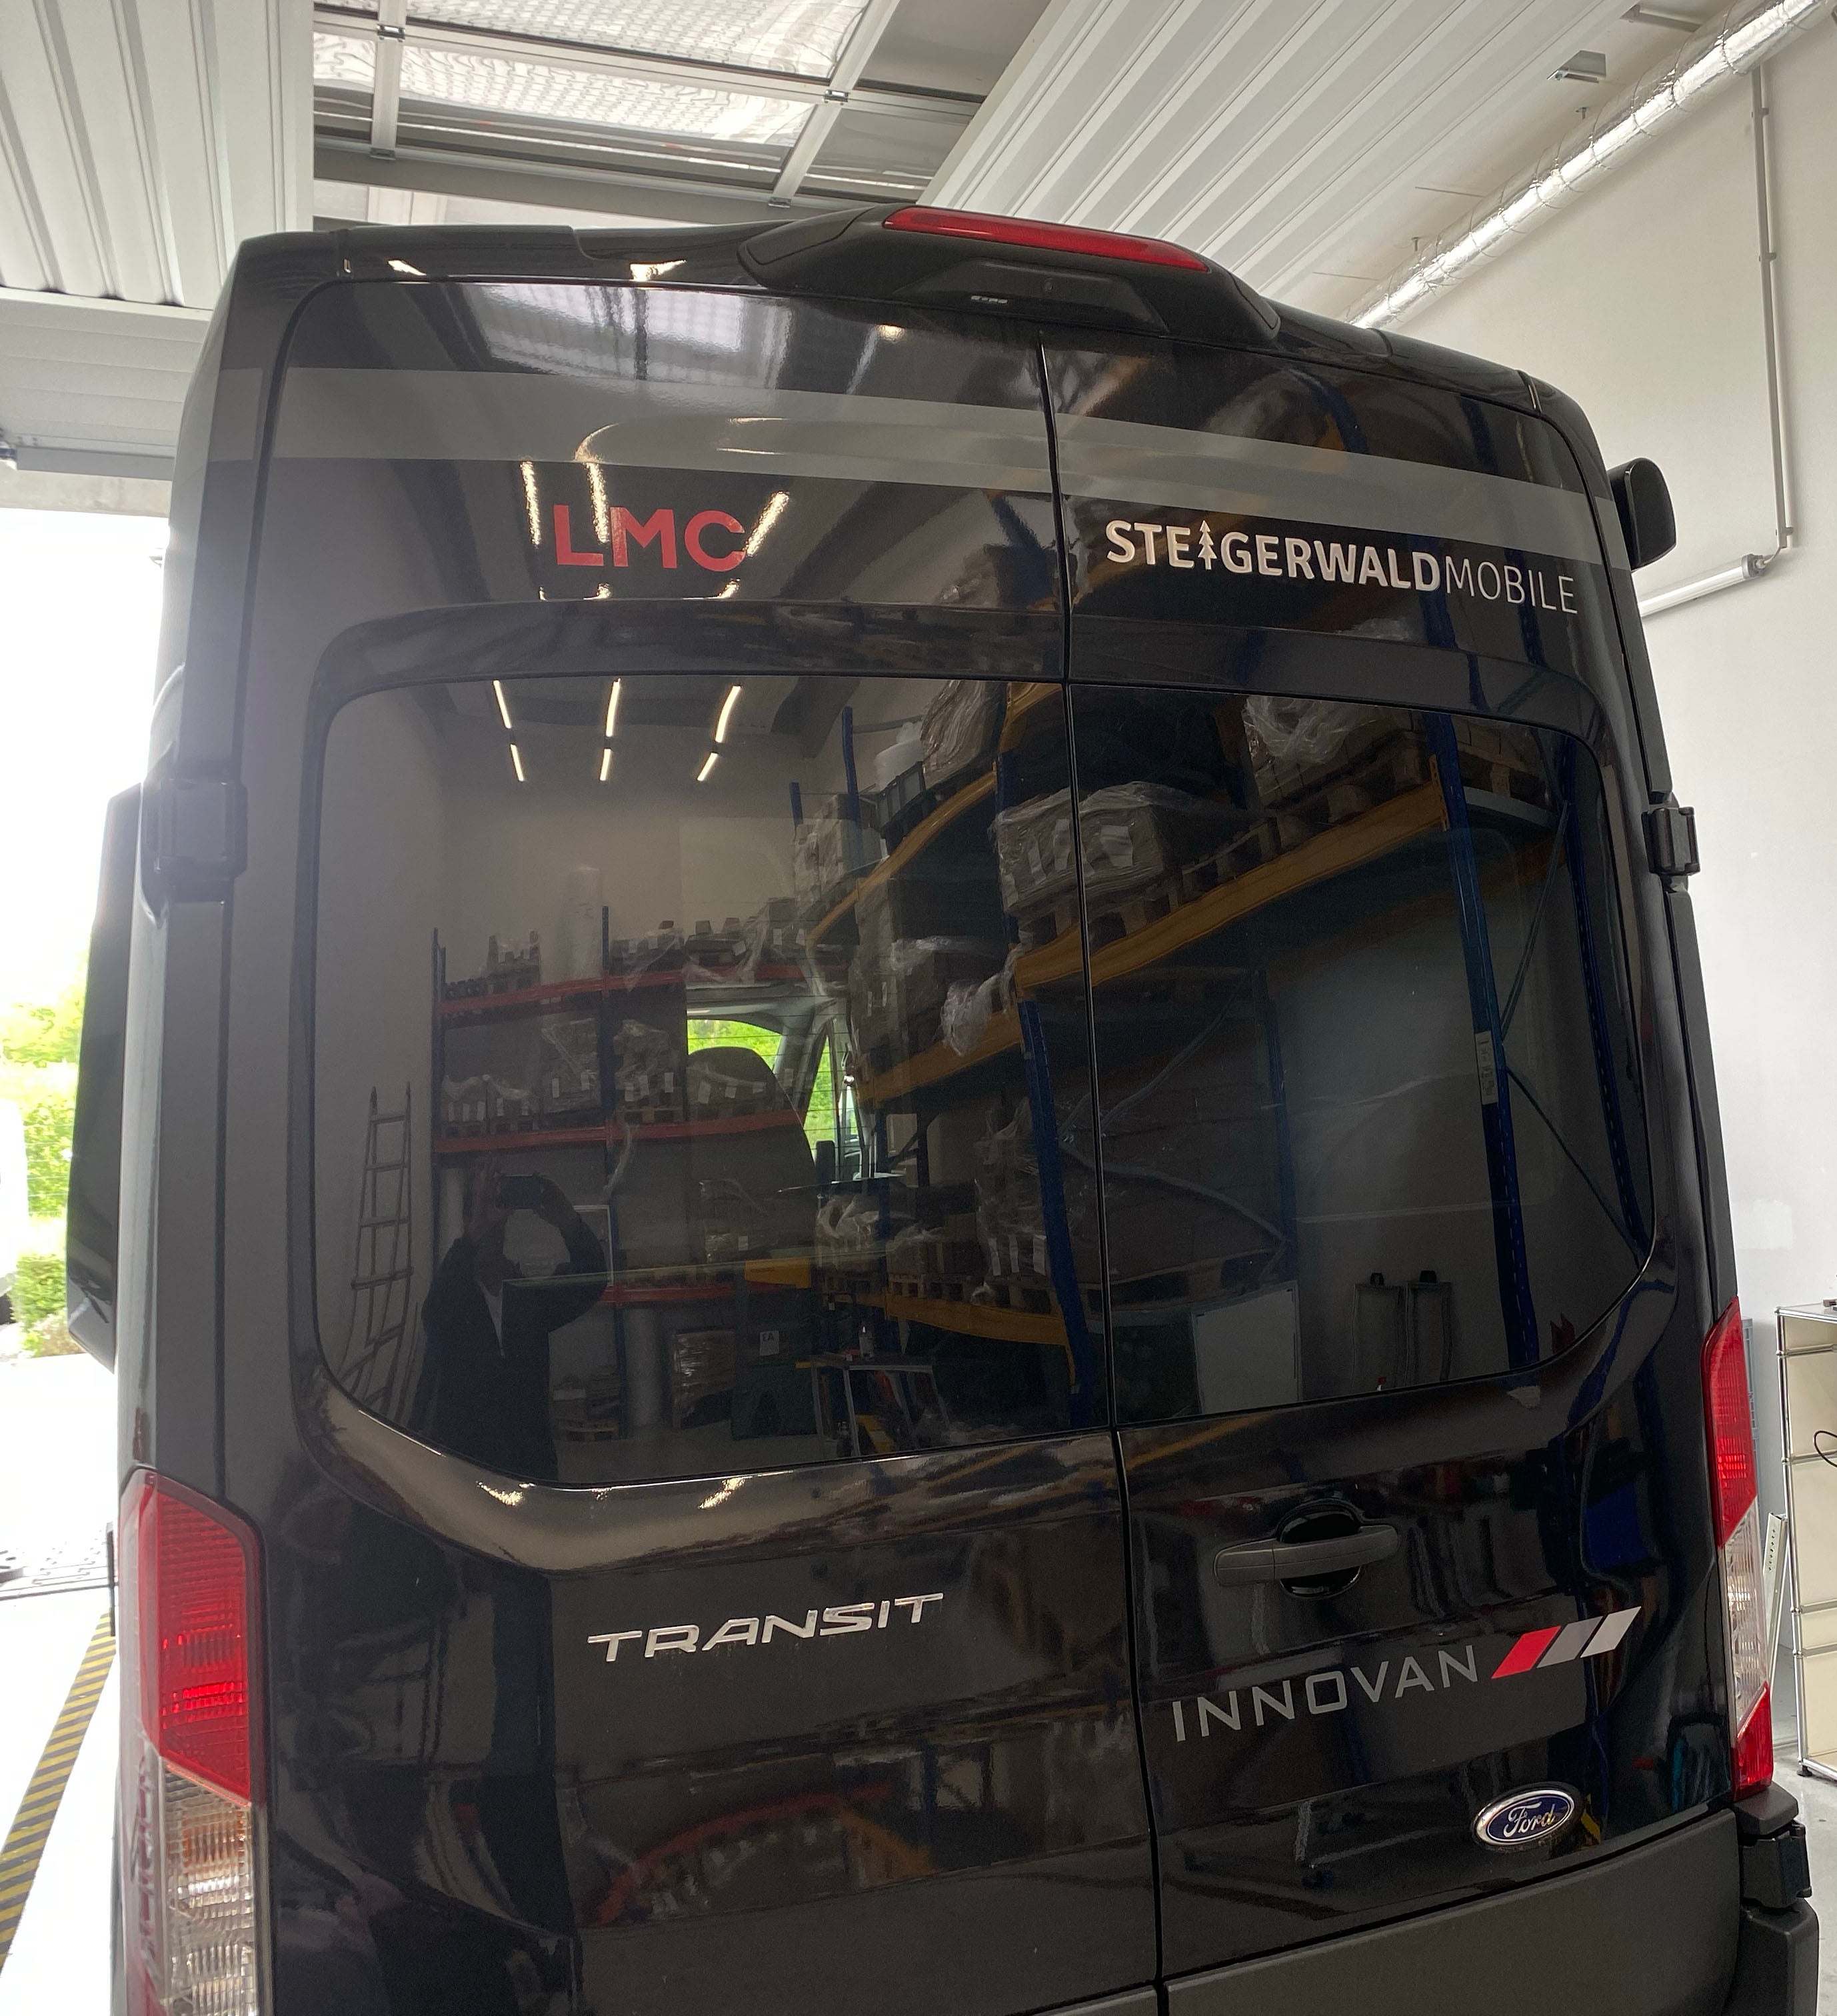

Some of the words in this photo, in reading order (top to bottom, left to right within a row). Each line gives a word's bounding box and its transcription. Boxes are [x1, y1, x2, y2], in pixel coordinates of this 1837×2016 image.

[553, 503, 747, 572] LMC
[587, 1592, 944, 1663] TRANSIT
[1172, 1643, 1479, 1742] INNOVAN
[1502, 1800, 1557, 1838] Ford
